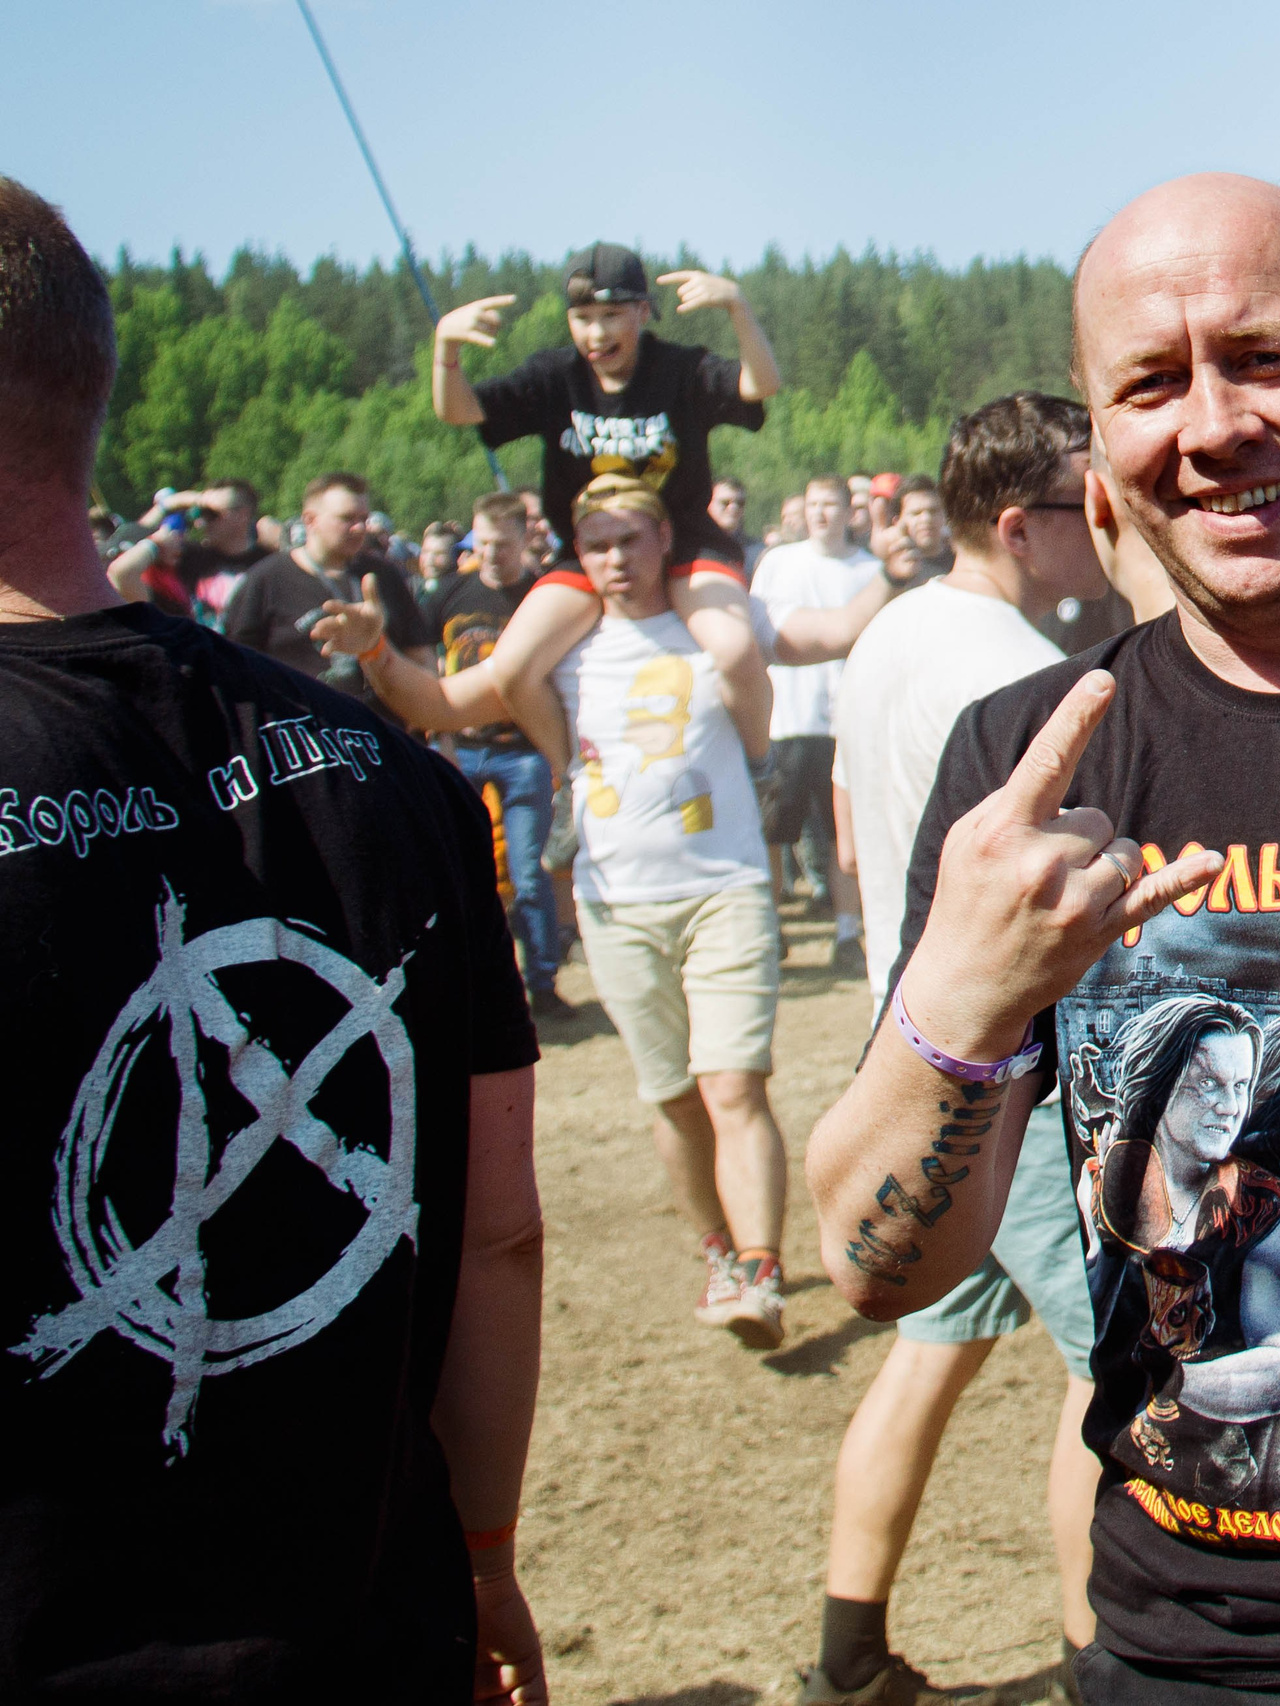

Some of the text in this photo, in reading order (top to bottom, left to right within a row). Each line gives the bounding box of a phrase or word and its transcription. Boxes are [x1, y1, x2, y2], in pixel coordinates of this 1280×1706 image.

[208, 755, 259, 811] и
[258, 714, 382, 785] Шут
[875, 1080, 1009, 1229] Zenit
